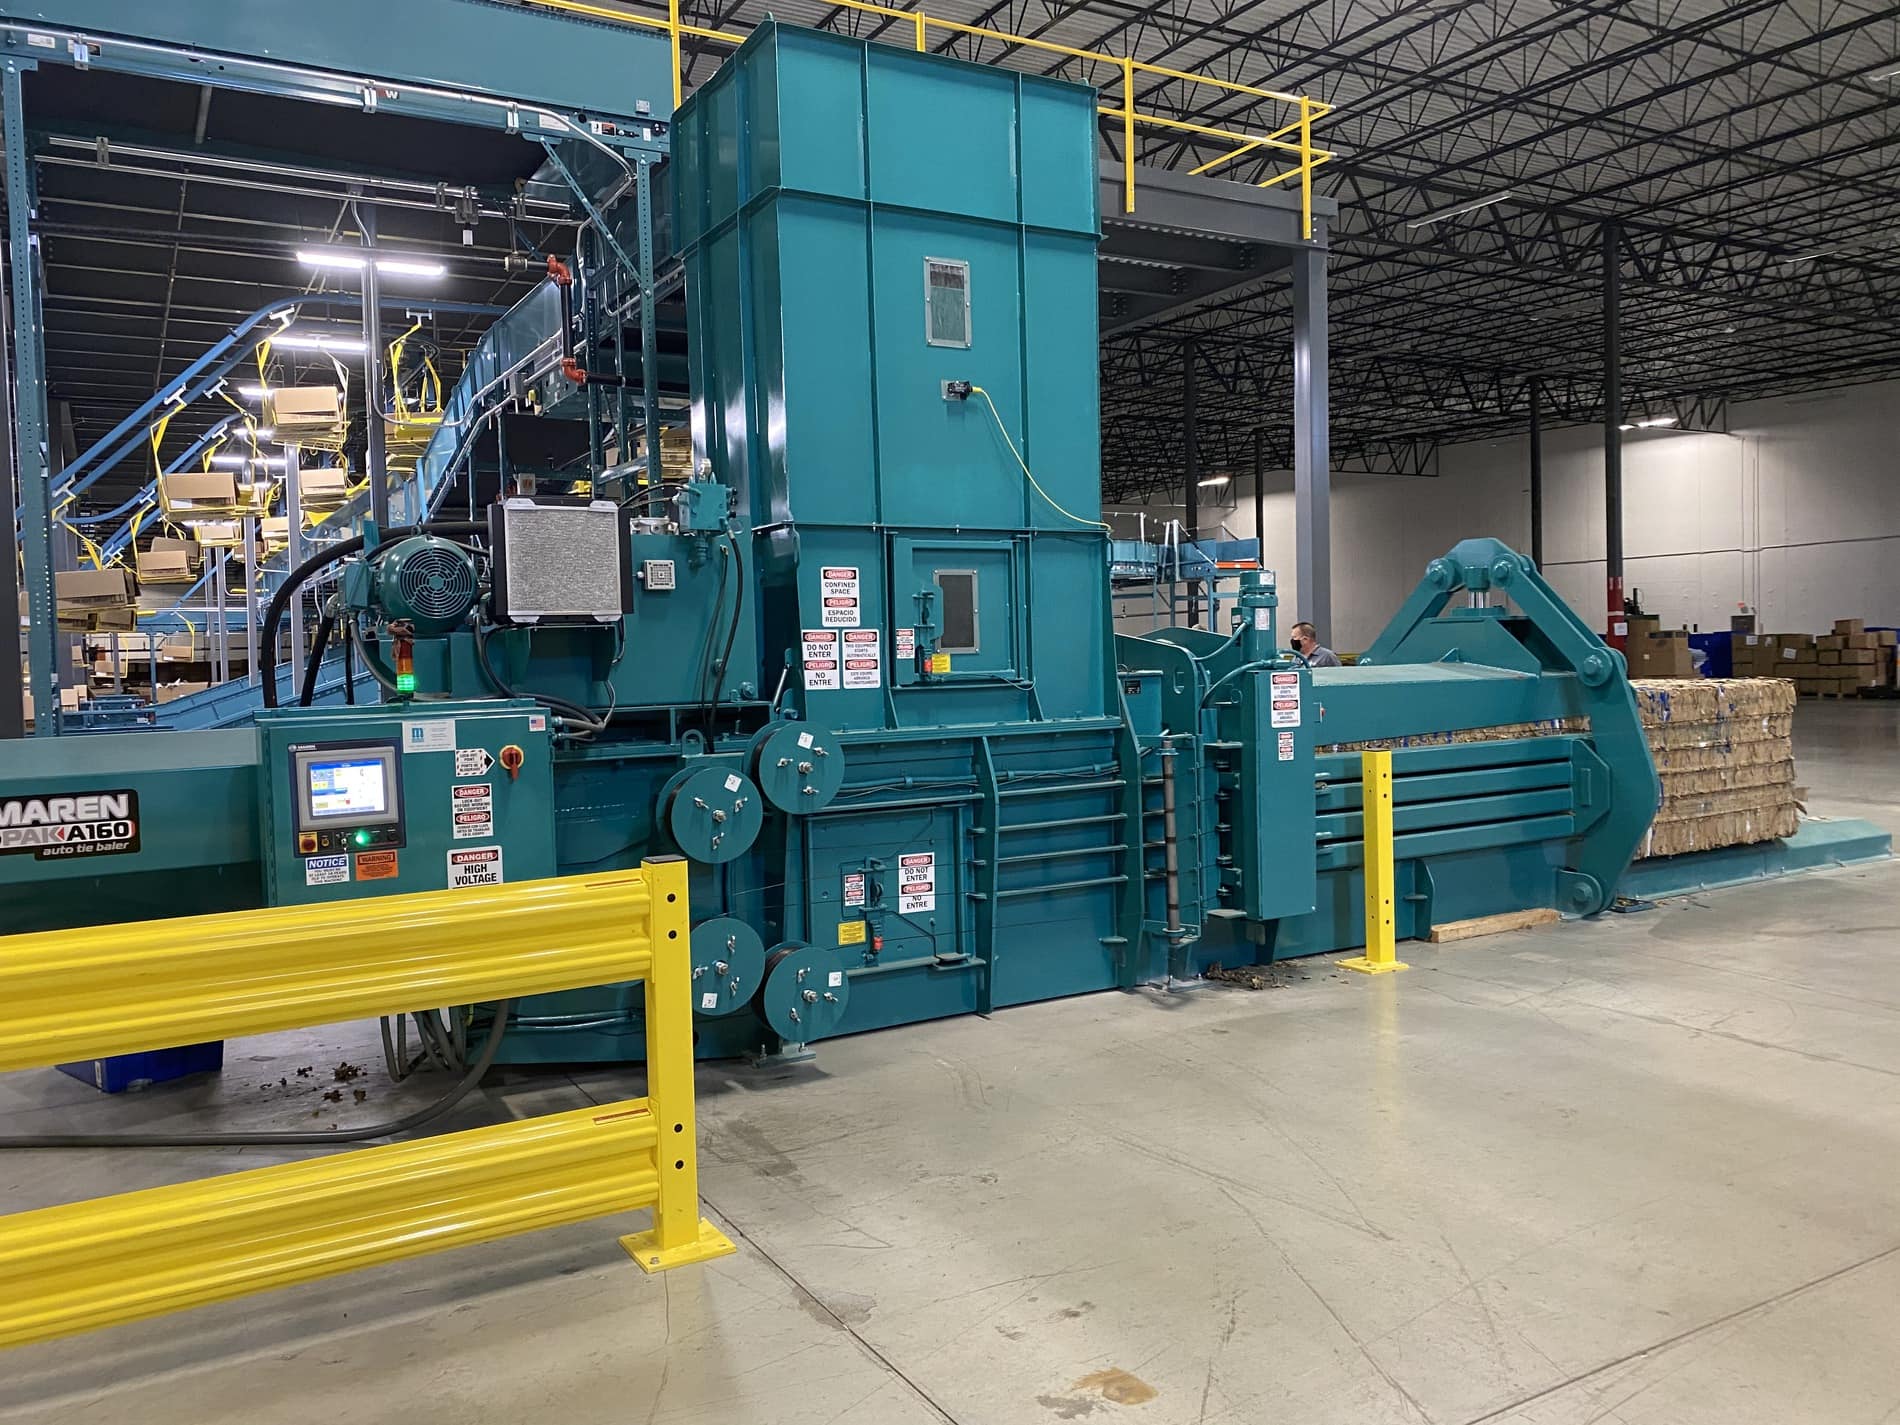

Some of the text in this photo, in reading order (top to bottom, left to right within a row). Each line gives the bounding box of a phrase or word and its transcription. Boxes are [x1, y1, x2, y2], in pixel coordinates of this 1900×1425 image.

[459, 788, 485, 796] DANGER
[459, 814, 486, 822] PELIGRO
[67, 822, 129, 841] A160
[43, 841, 130, 856] auto tie baler
[308, 857, 346, 869] NOTICE
[456, 852, 494, 863] DANGER
[464, 864, 488, 874] HIGH
[455, 872, 497, 885] VOLTAGE
[907, 901, 928, 909] ENTRE
